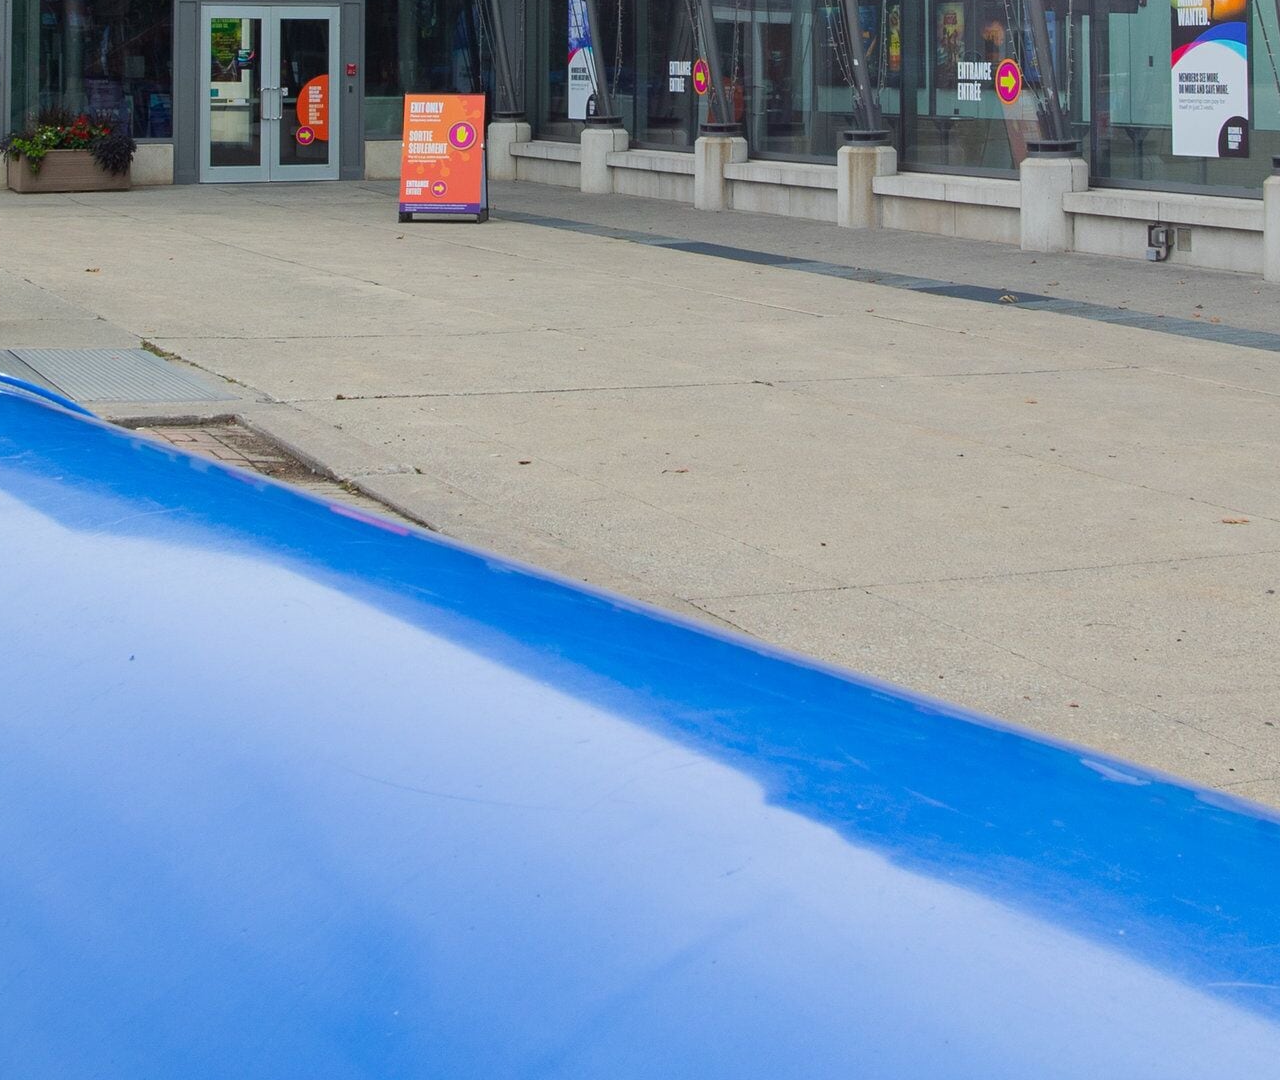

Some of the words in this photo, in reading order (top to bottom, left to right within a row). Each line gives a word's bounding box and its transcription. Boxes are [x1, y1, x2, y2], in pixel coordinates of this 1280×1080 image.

[1177, 7, 1210, 26] WANTED.
[669, 61, 691, 76] ENTRANCE
[958, 62, 992, 80] ENTRANCE
[669, 76, 685, 92] ENTRÉE
[1178, 73, 1199, 82] MEMBERS
[958, 81, 981, 101] ENTRÉE
[1185, 84, 1196, 94] MORE
[1197, 84, 1205, 94] AND
[1205, 84, 1215, 94] SAVE
[410, 102, 425, 113] EXIT
[426, 102, 444, 113] ONLY
[409, 130, 433, 141] SORTIE
[408, 142, 448, 154] SEULEMENT
